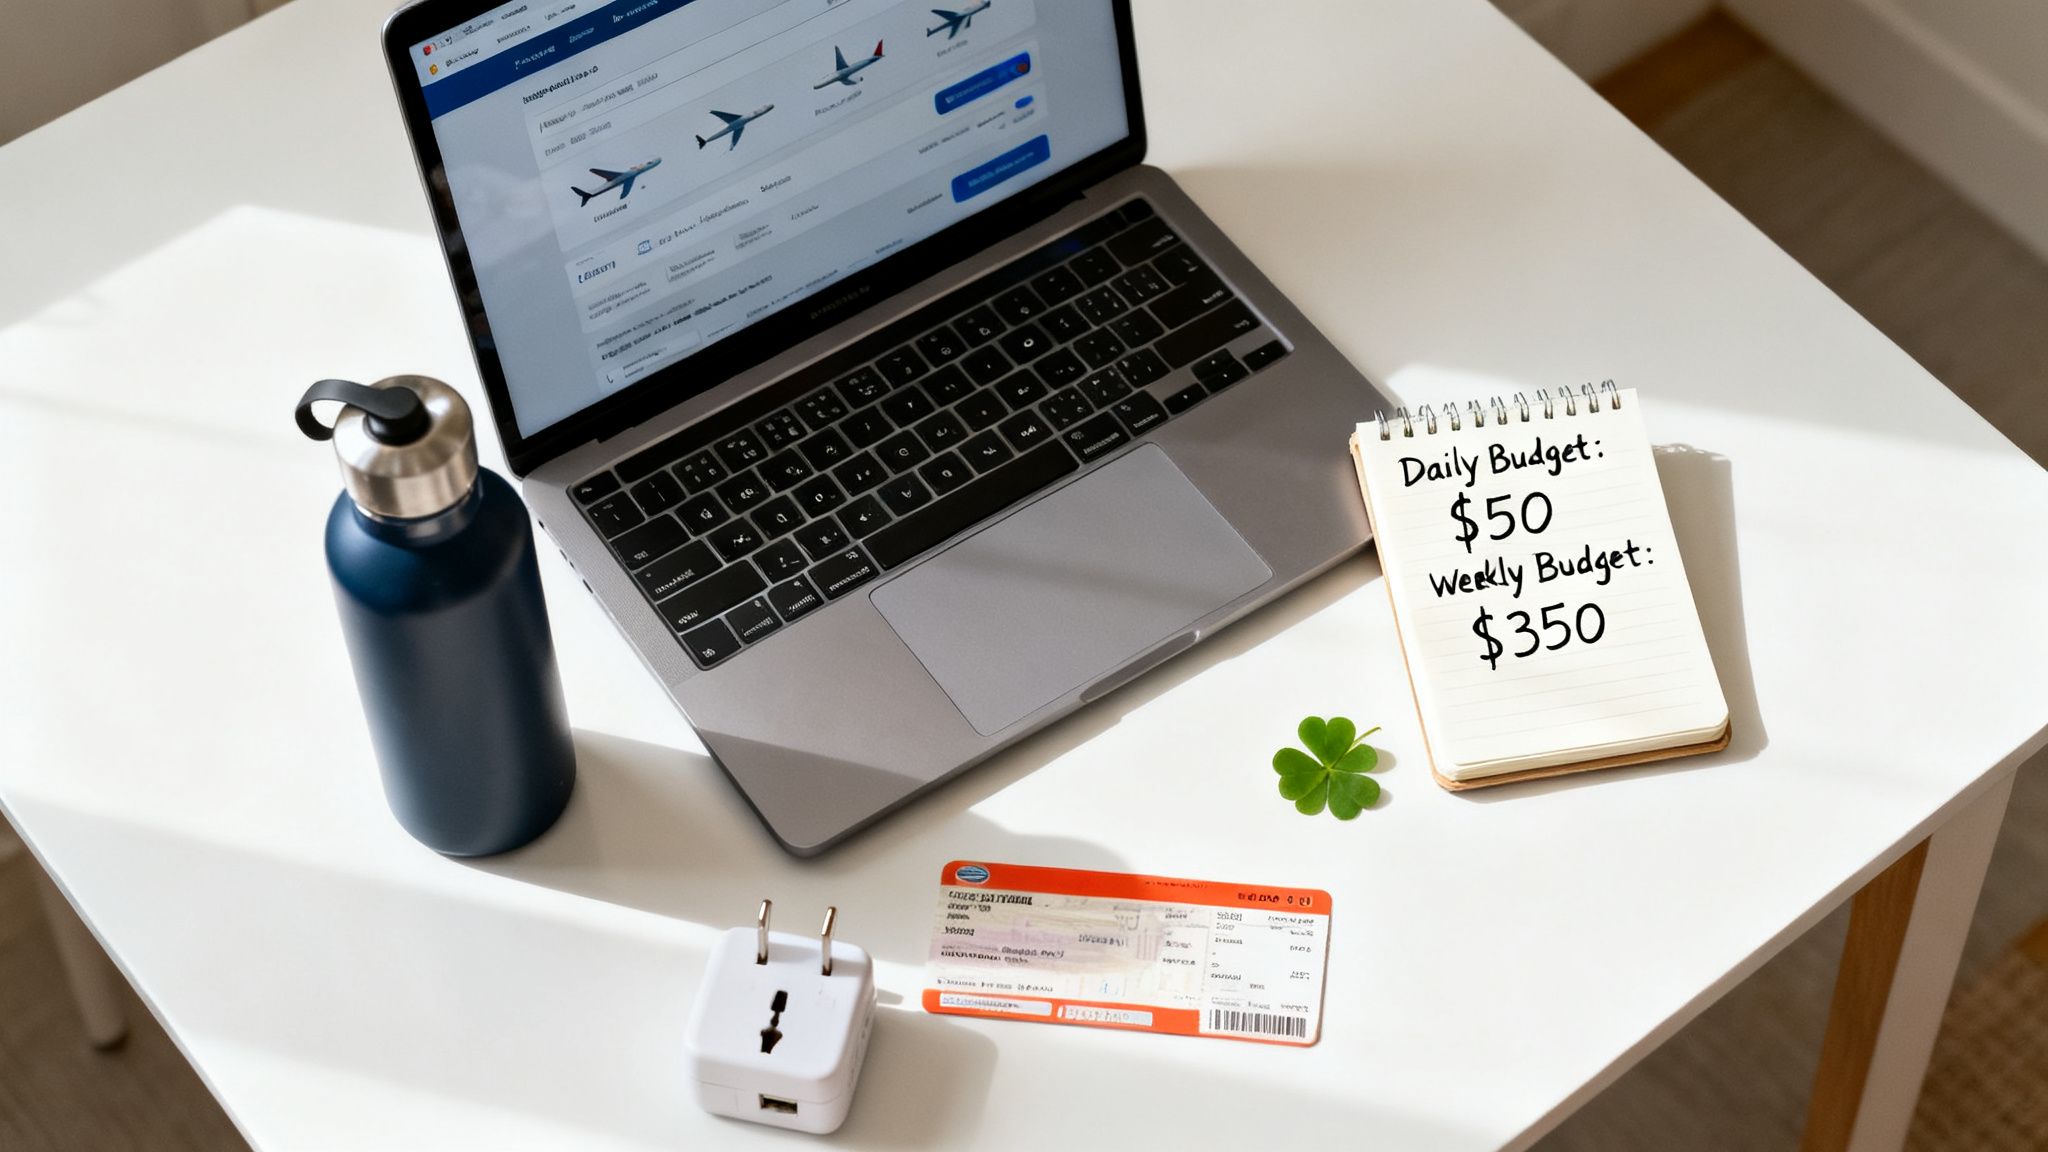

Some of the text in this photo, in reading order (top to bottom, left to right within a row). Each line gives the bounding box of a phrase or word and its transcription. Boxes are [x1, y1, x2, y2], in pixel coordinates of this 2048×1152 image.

[1399, 434, 1604, 487] Daily Budget:
[1450, 492, 1553, 553] $50
[1429, 540, 1654, 598] Weekly Budget:
[1472, 602, 1606, 670] $350
